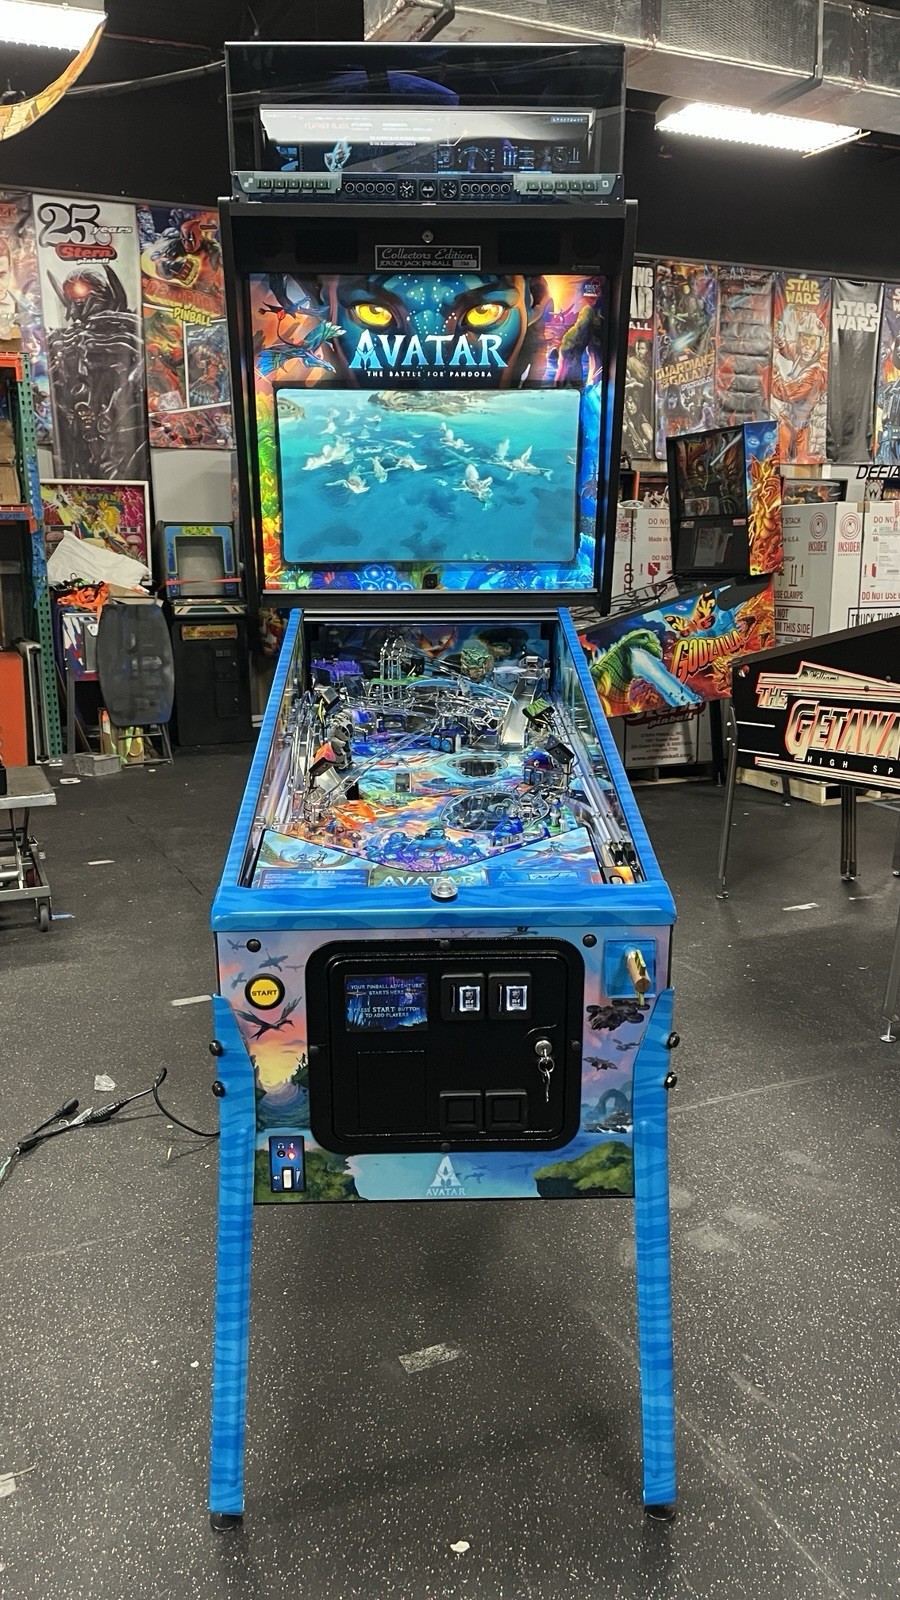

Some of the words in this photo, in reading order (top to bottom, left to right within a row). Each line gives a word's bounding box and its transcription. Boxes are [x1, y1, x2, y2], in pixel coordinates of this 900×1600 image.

[38, 203, 100, 247] 25
[91, 226, 133, 235] years
[61, 246, 111, 258] Stern
[381, 248, 431, 260] Collectors
[434, 248, 474, 260] Edition
[785, 279, 820, 293] STAR
[785, 291, 820, 305] WARS
[832, 300, 879, 318] STAR
[173, 307, 213, 326] PINBALL
[833, 314, 879, 333] WARS
[348, 328, 509, 370] AVATAR
[648, 517, 658, 525] DO
[785, 517, 801, 525] STACK
[873, 516, 884, 524] DO
[808, 541, 827, 552] INSIDER
[837, 541, 860, 552] INSIDER
[784, 590, 803, 600] CLAMPS
[861, 591, 871, 601] DO
[777, 608, 789, 619] NOT
[783, 622, 796, 633] THIS
[797, 623, 810, 634] SIDE
[670, 629, 742, 685] GODZILLA
[757, 686, 788, 709] THE
[648, 713, 694, 729] pinball
[807, 757, 848, 769] HIGH
[426, 1188, 466, 1196] AVATAR
